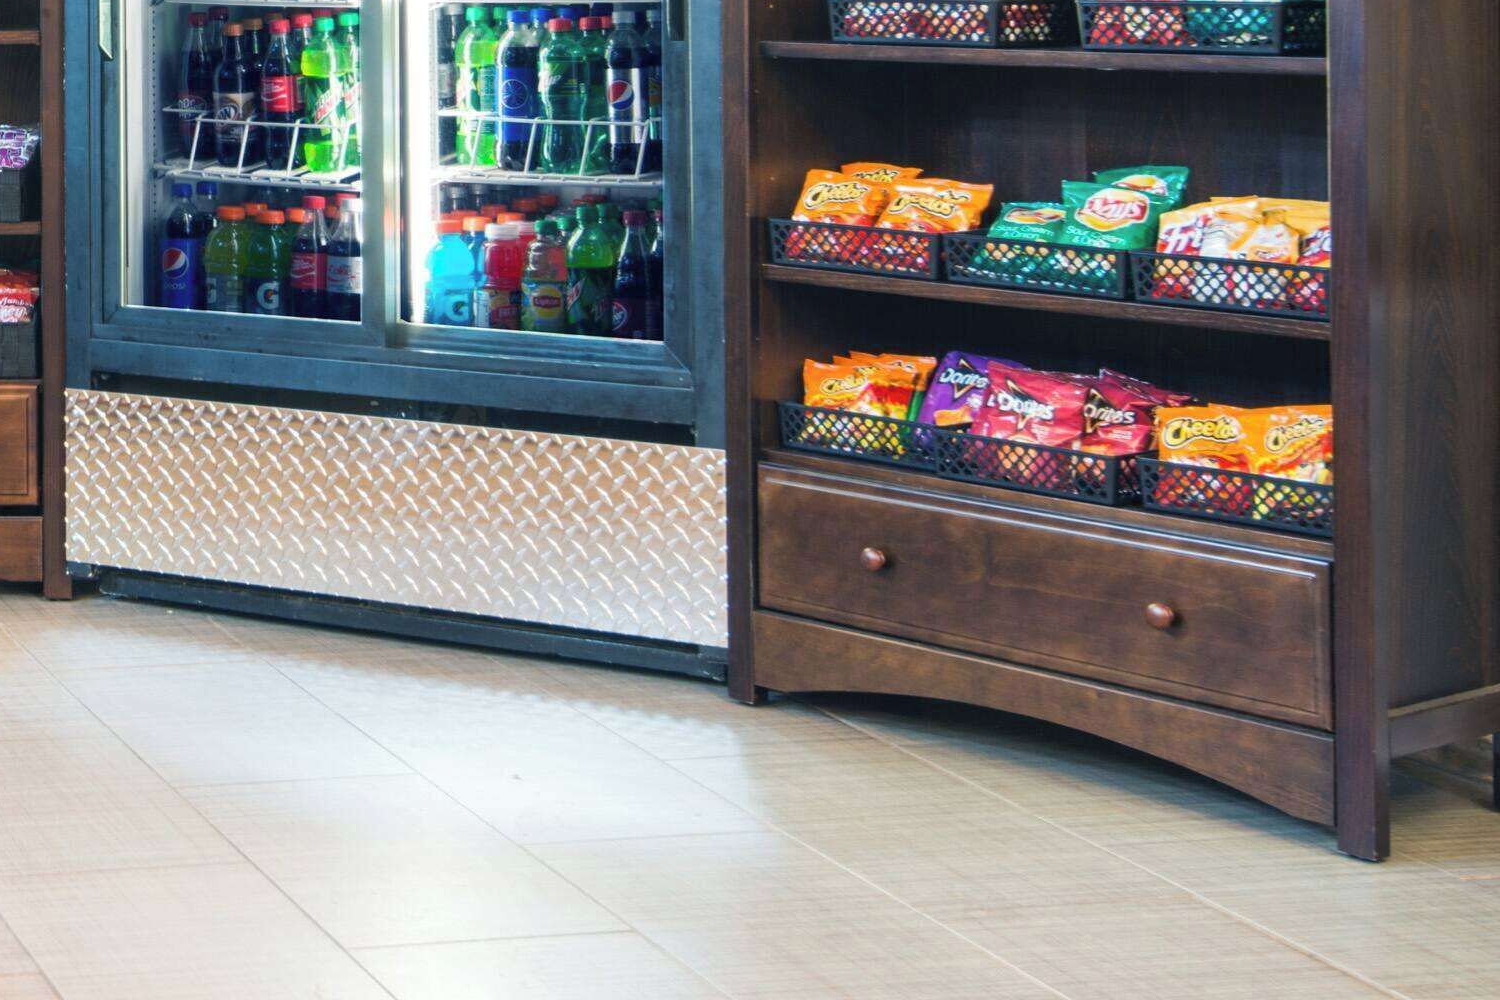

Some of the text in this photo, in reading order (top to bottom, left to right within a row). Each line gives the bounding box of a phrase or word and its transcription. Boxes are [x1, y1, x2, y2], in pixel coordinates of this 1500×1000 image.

[940, 367, 990, 389] Doritos
[1083, 403, 1137, 424] oritos
[1163, 415, 1240, 449] Cheetos
